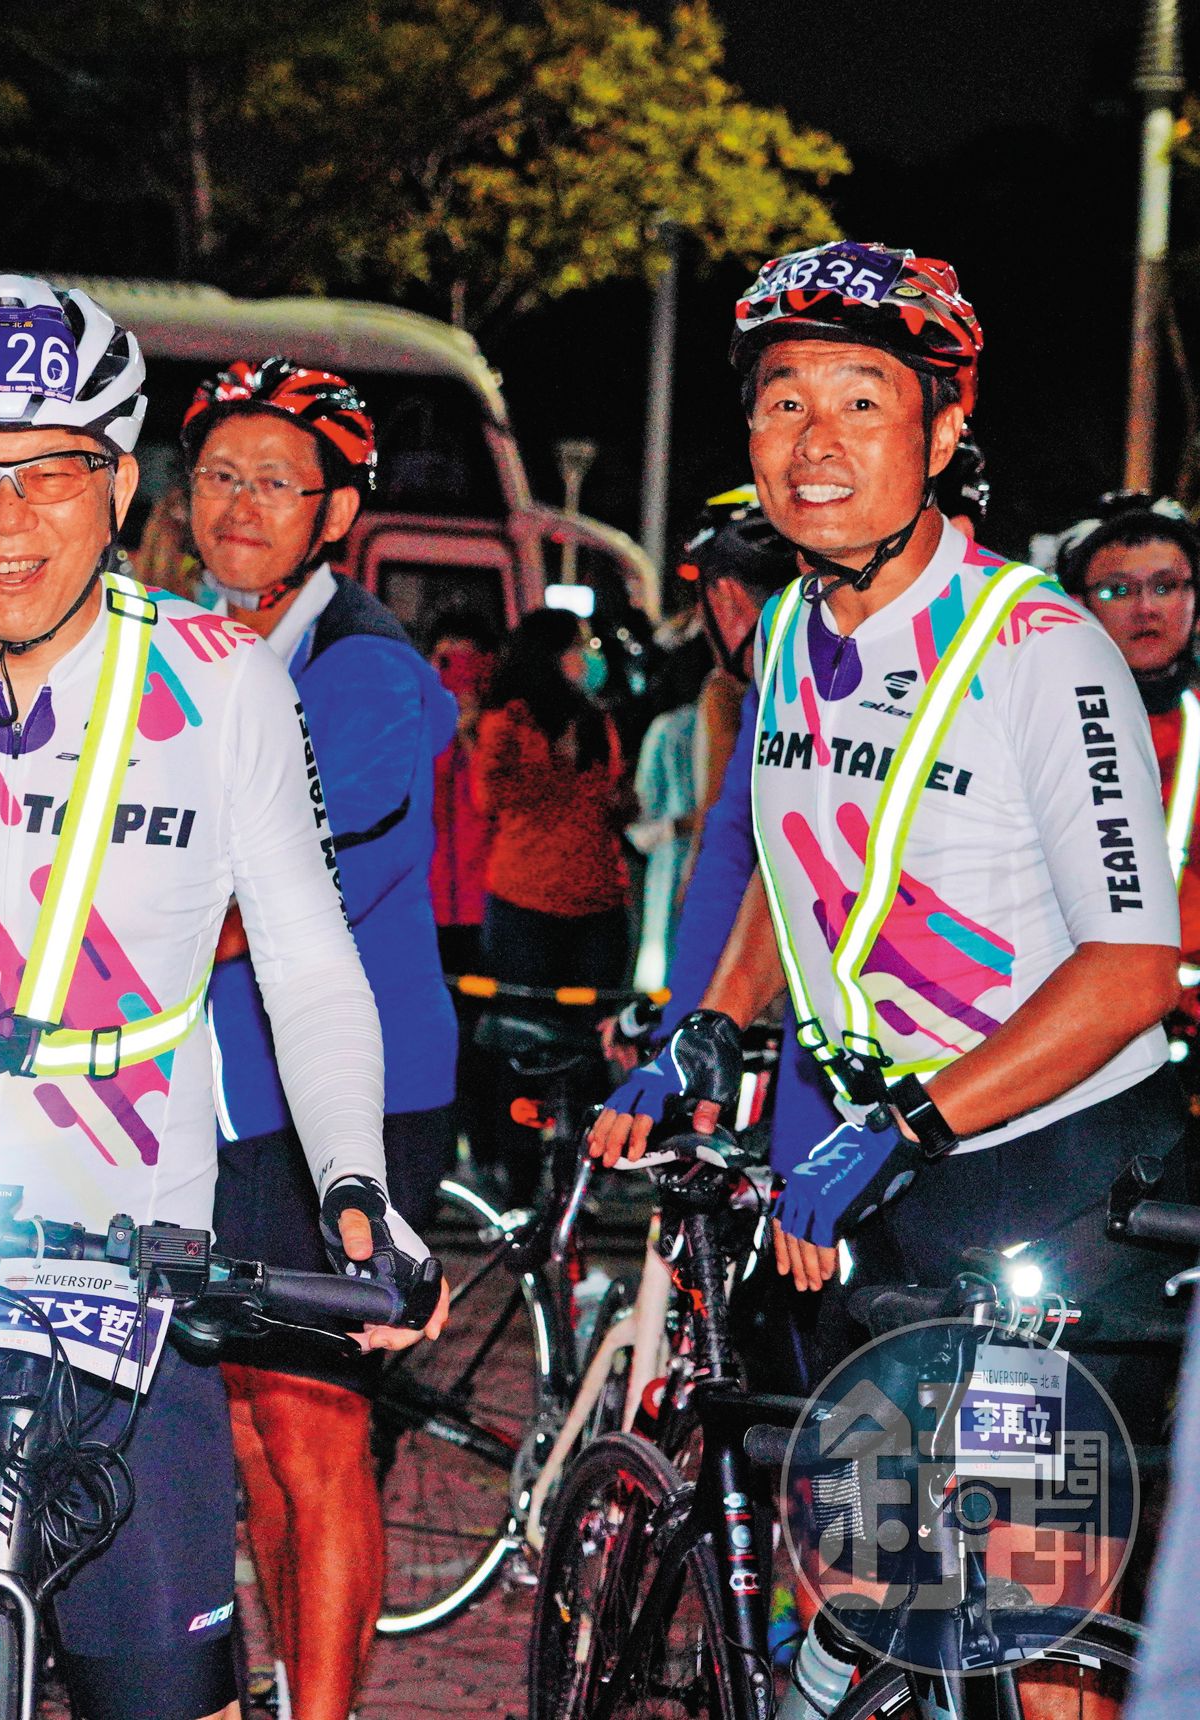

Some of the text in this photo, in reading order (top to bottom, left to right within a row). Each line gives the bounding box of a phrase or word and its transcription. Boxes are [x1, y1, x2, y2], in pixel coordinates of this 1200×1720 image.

[757, 731, 973, 796] EAM TAIEI
[23, 793, 197, 848] TPEI
[1074, 685, 1143, 913] TEAM TAIPEI
[35, 1274, 113, 1291] NEVERSTOP
[982, 1369, 1060, 1390] NEVERSTOP 北高
[972, 1399, 1052, 1446] 李再立
